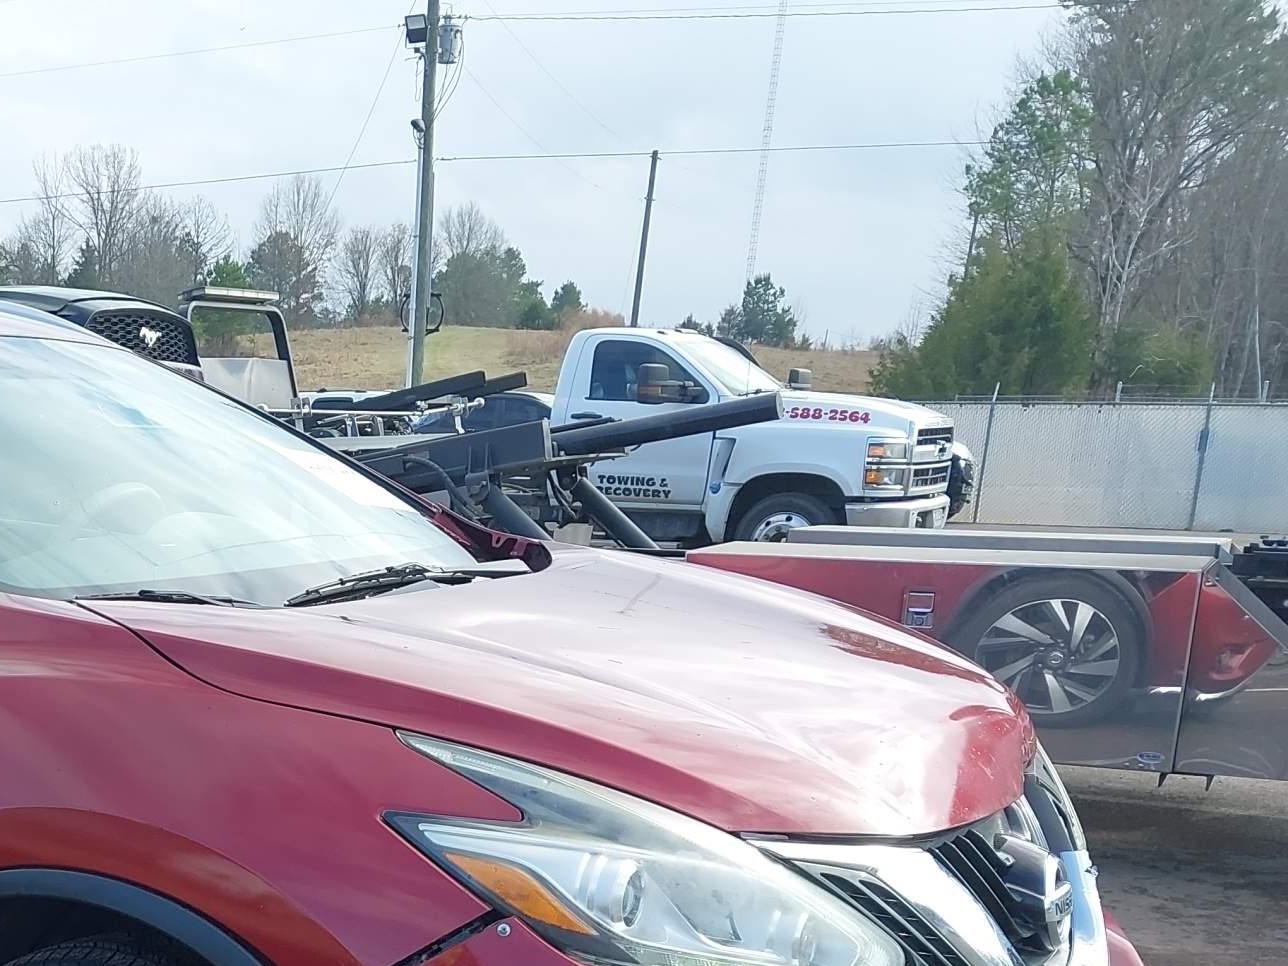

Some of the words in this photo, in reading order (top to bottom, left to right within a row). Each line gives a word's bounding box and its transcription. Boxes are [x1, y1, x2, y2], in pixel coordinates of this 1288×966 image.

[782, 407, 871, 424] -588-2564
[597, 474, 656, 487] TOWING
[659, 478, 669, 488] &
